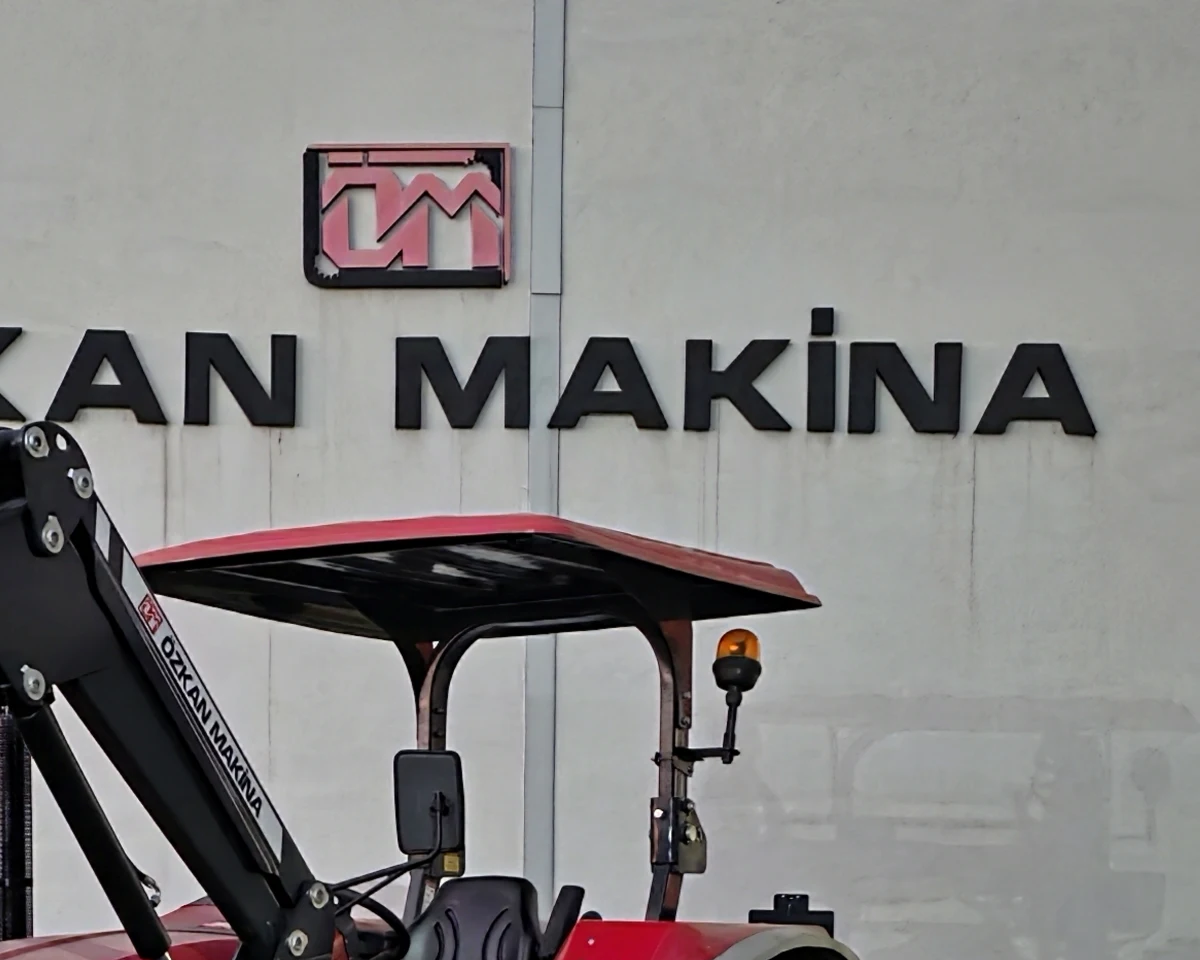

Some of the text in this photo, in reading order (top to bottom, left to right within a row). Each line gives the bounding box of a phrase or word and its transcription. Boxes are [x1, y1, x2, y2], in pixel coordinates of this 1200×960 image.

[395, 307, 1097, 437] MAKİNA
[160, 634, 264, 818] ÖZKAN MAKİNA
